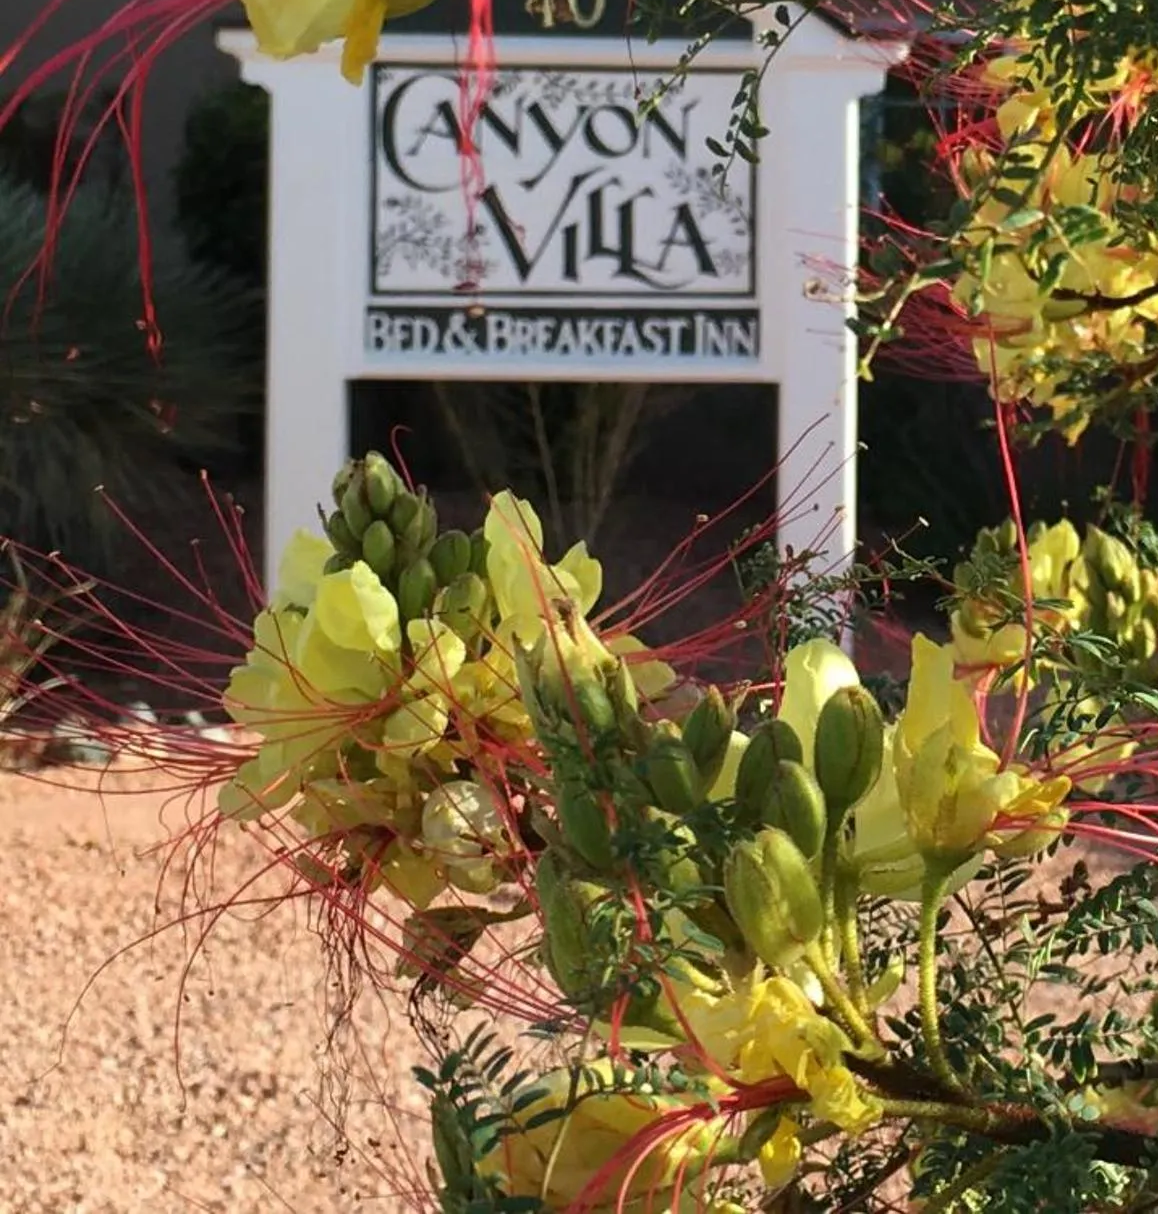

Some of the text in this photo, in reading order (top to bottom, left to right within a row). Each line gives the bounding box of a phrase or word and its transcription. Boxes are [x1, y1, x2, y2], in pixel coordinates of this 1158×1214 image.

[383, 74, 698, 192] CANYON
[477, 166, 718, 291] VILLA
[369, 312, 757, 357] BED & BREAKFAST INN
